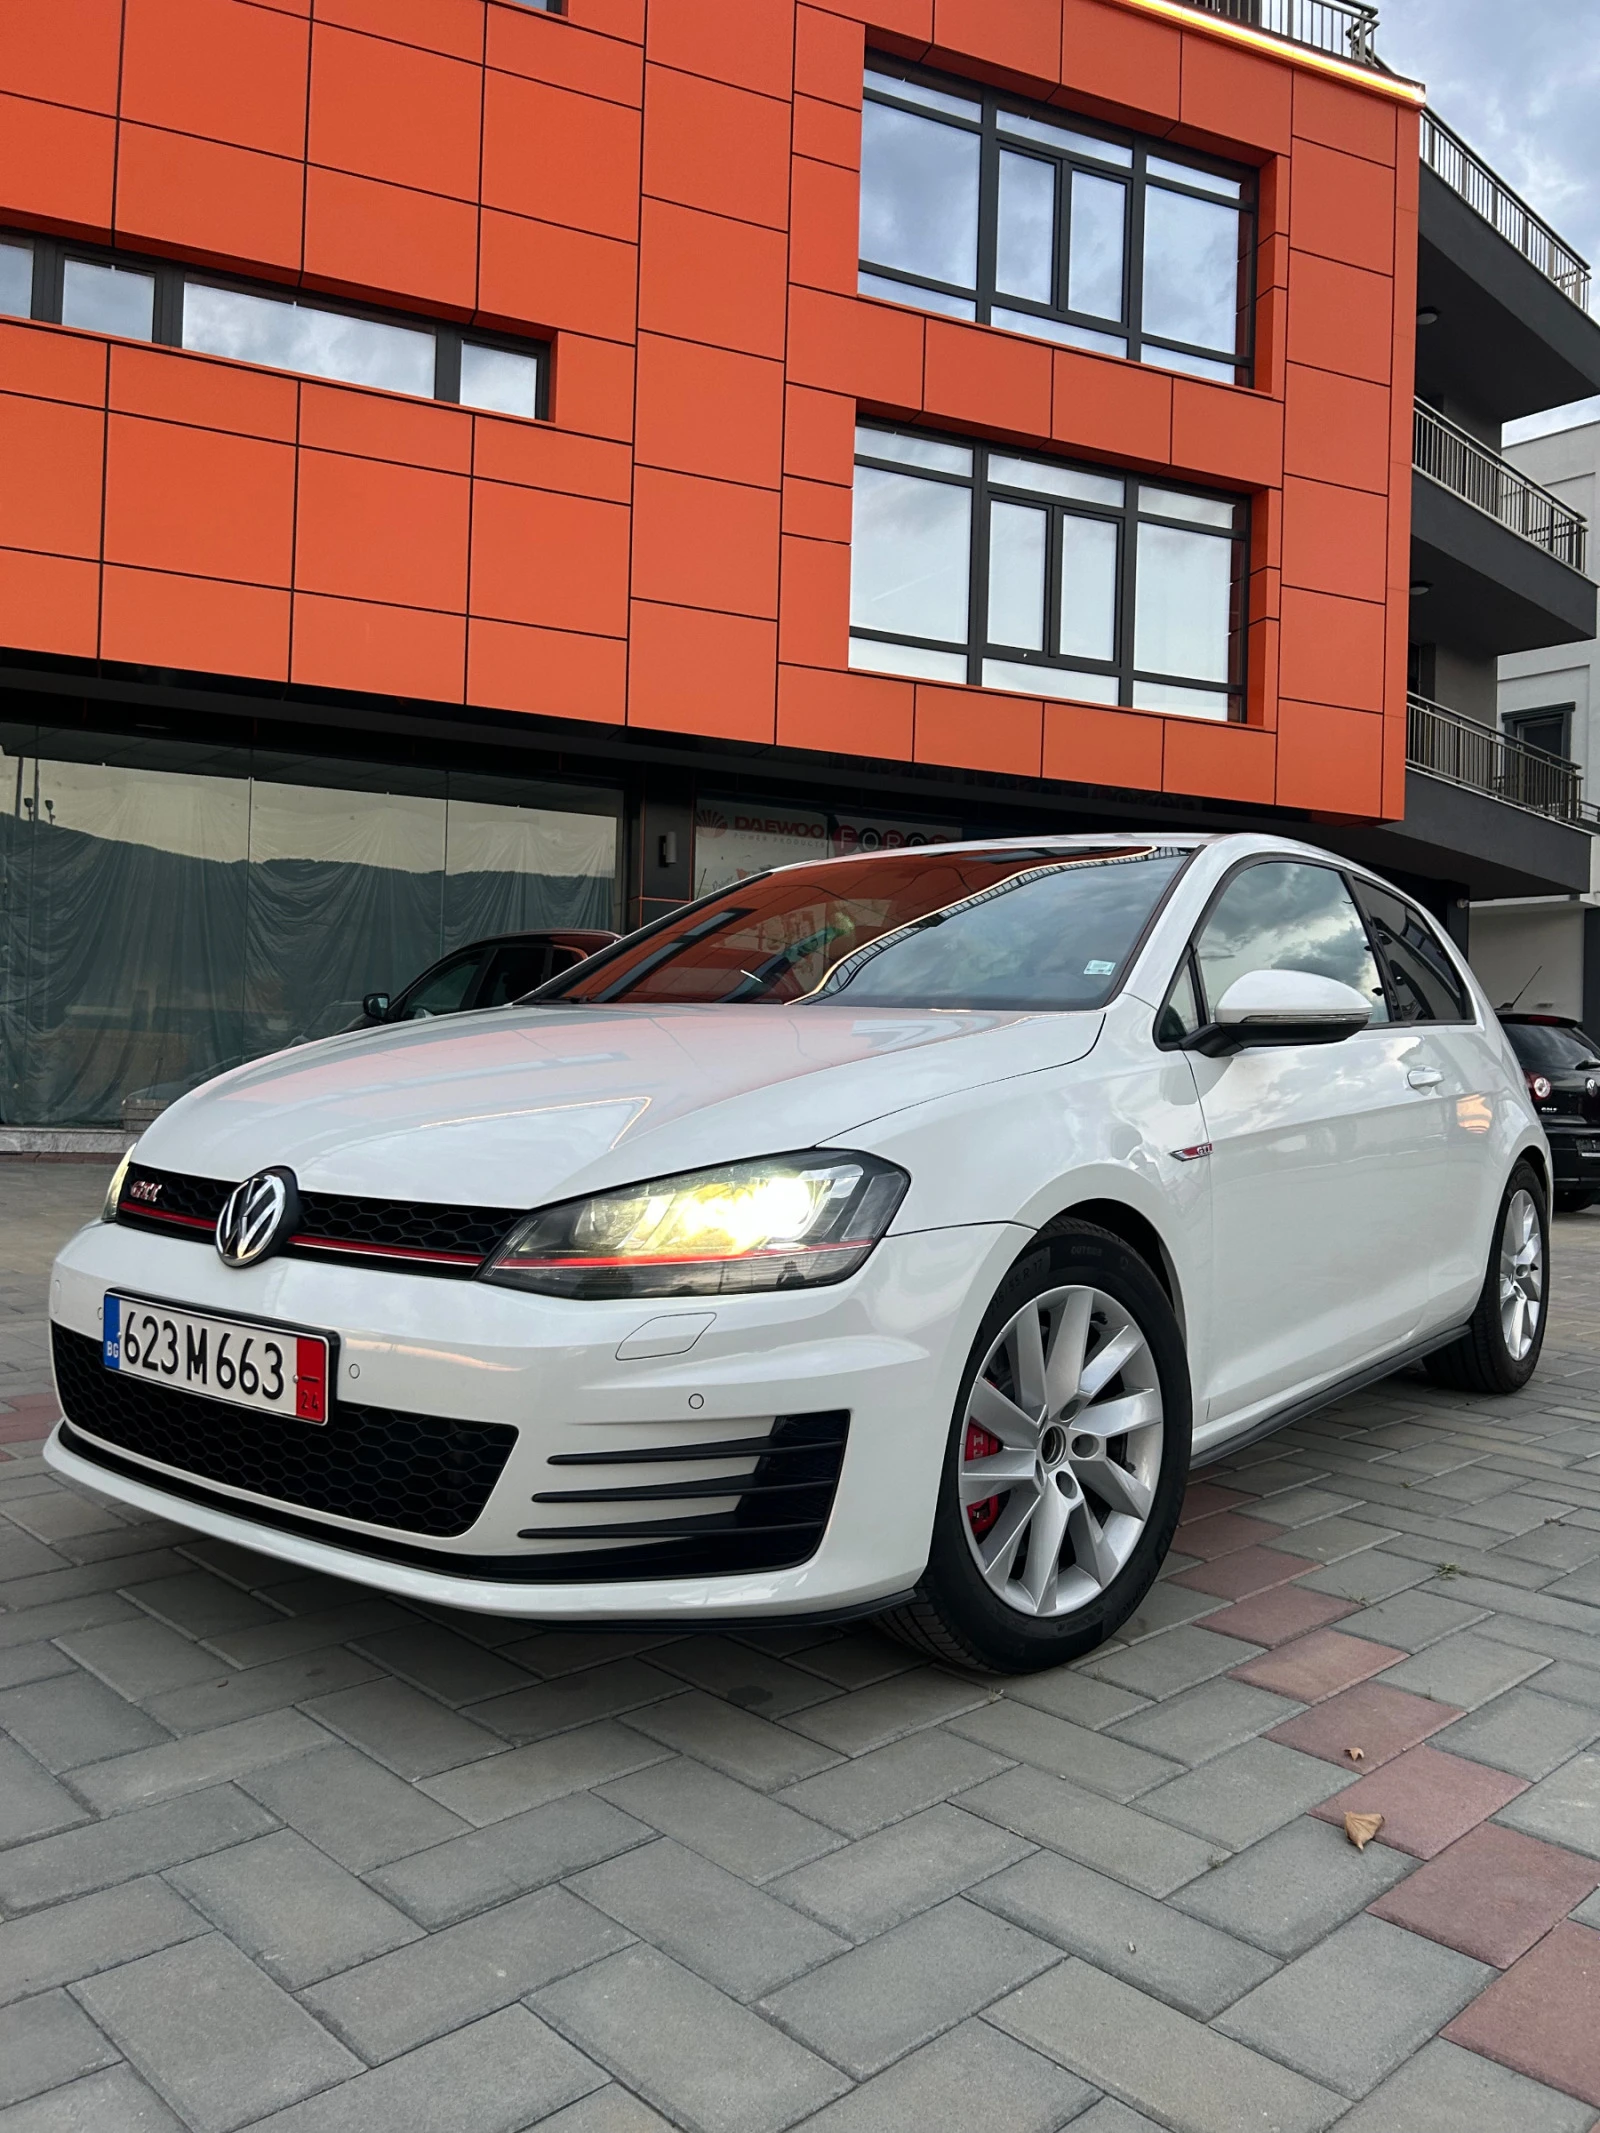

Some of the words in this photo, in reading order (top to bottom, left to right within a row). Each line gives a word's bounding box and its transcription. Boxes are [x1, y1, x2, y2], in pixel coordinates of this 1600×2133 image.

[734, 815, 825, 838] DAEWOO
[734, 832, 768, 842] POWER
[773, 837, 825, 848] PRODUCTS
[840, 828, 947, 851] FOR
[130, 1180, 162, 1202] GTI
[106, 1340, 119, 1358] BG
[300, 1390, 319, 1411] 24
